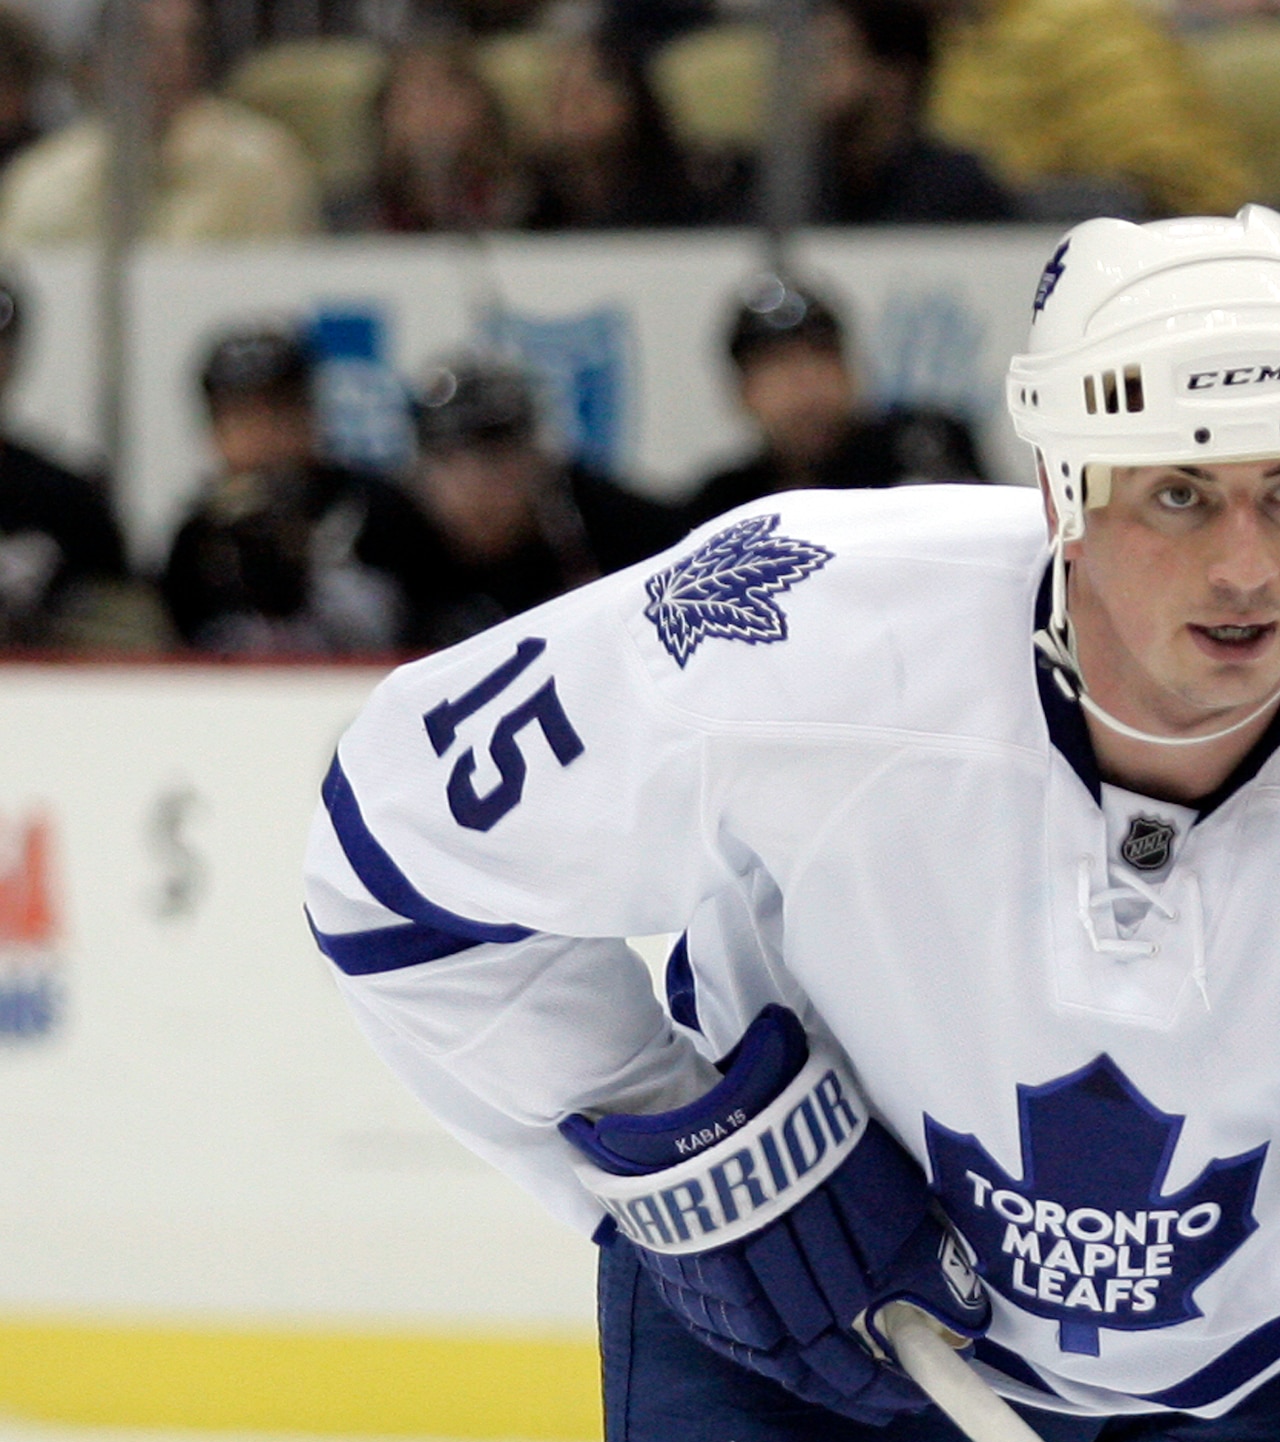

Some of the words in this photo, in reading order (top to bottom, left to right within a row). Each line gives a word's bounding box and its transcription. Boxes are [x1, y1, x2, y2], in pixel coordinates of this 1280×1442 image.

[423, 636, 585, 833] 15
[674, 1121, 727, 1154] KABA
[727, 1109, 746, 1127] 15
[966, 1169, 1221, 1242] TORONTO
[1002, 1222, 1174, 1278] MAPLE
[1013, 1258, 1160, 1313] LEAFS
